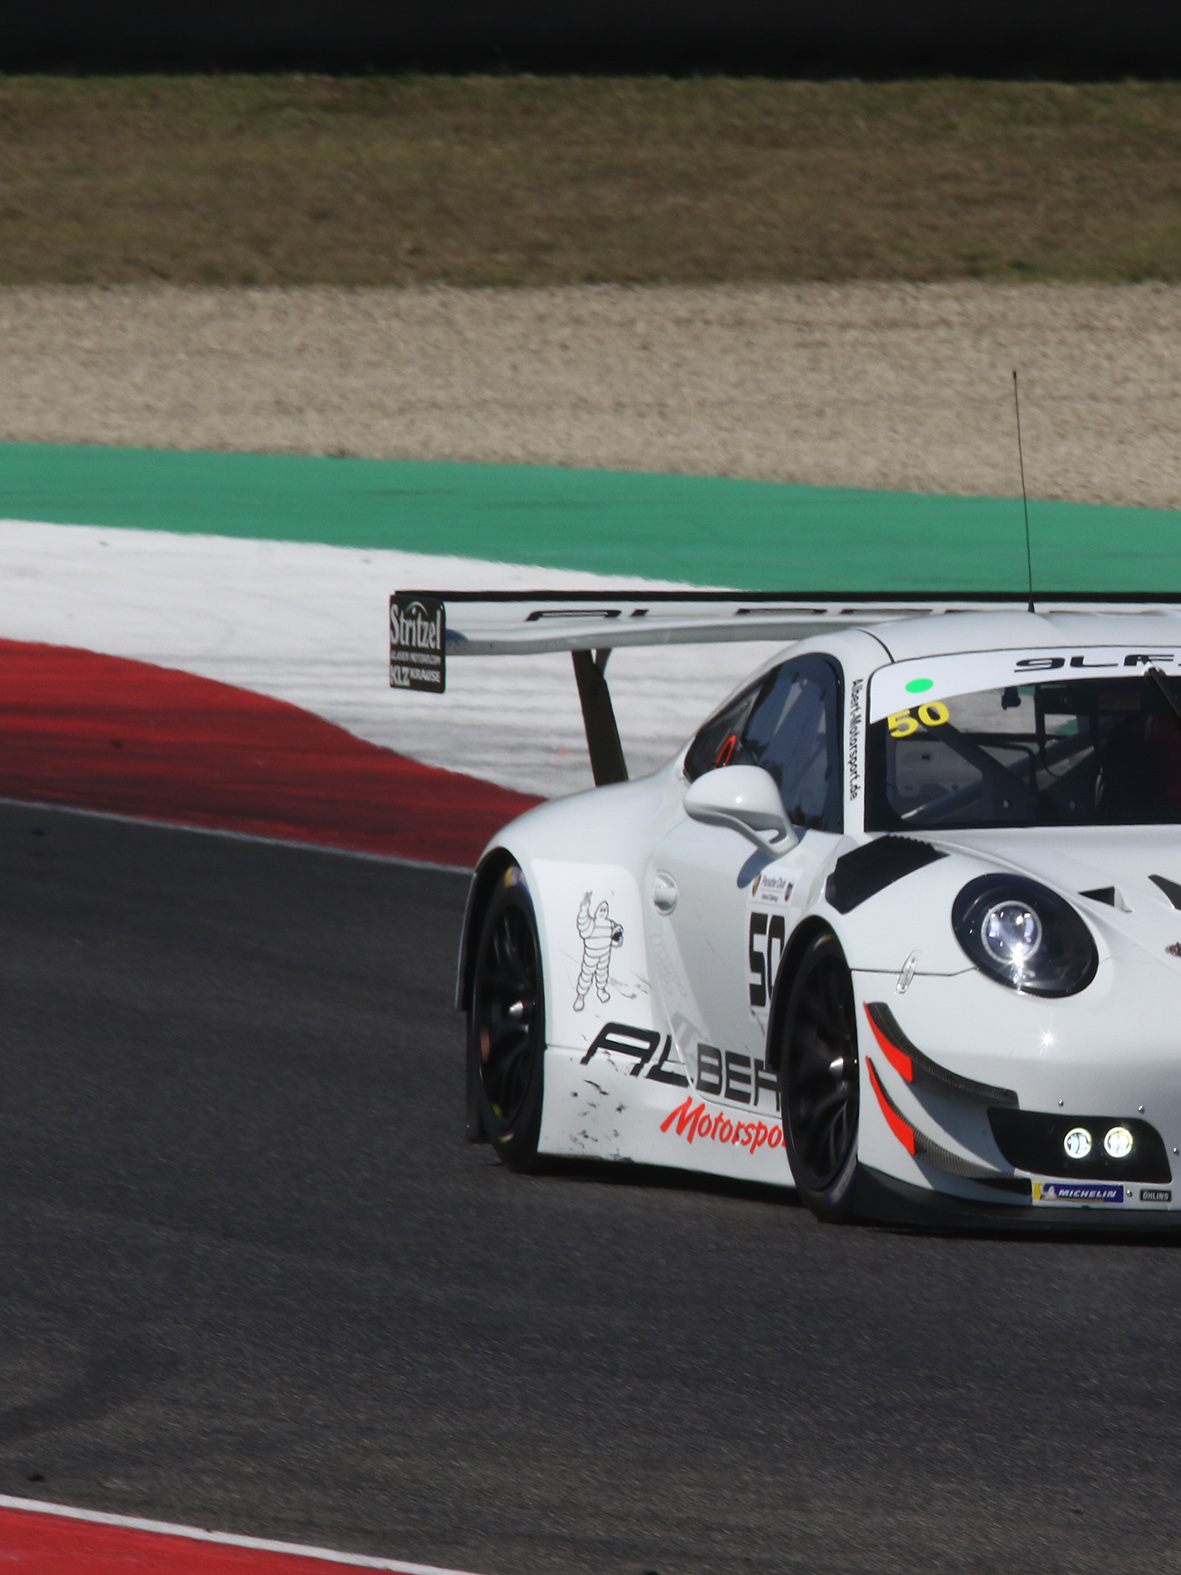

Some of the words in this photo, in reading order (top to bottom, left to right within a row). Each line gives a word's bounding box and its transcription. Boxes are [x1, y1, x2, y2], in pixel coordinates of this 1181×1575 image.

[390, 603, 441, 650] Stritzel
[848, 679, 864, 801] Albert-Motorsport.de
[887, 701, 950, 738] 50
[749, 911, 786, 1007] 50
[660, 1095, 787, 1155] Motorspo
[1058, 1189, 1118, 1199] MICHELIN
